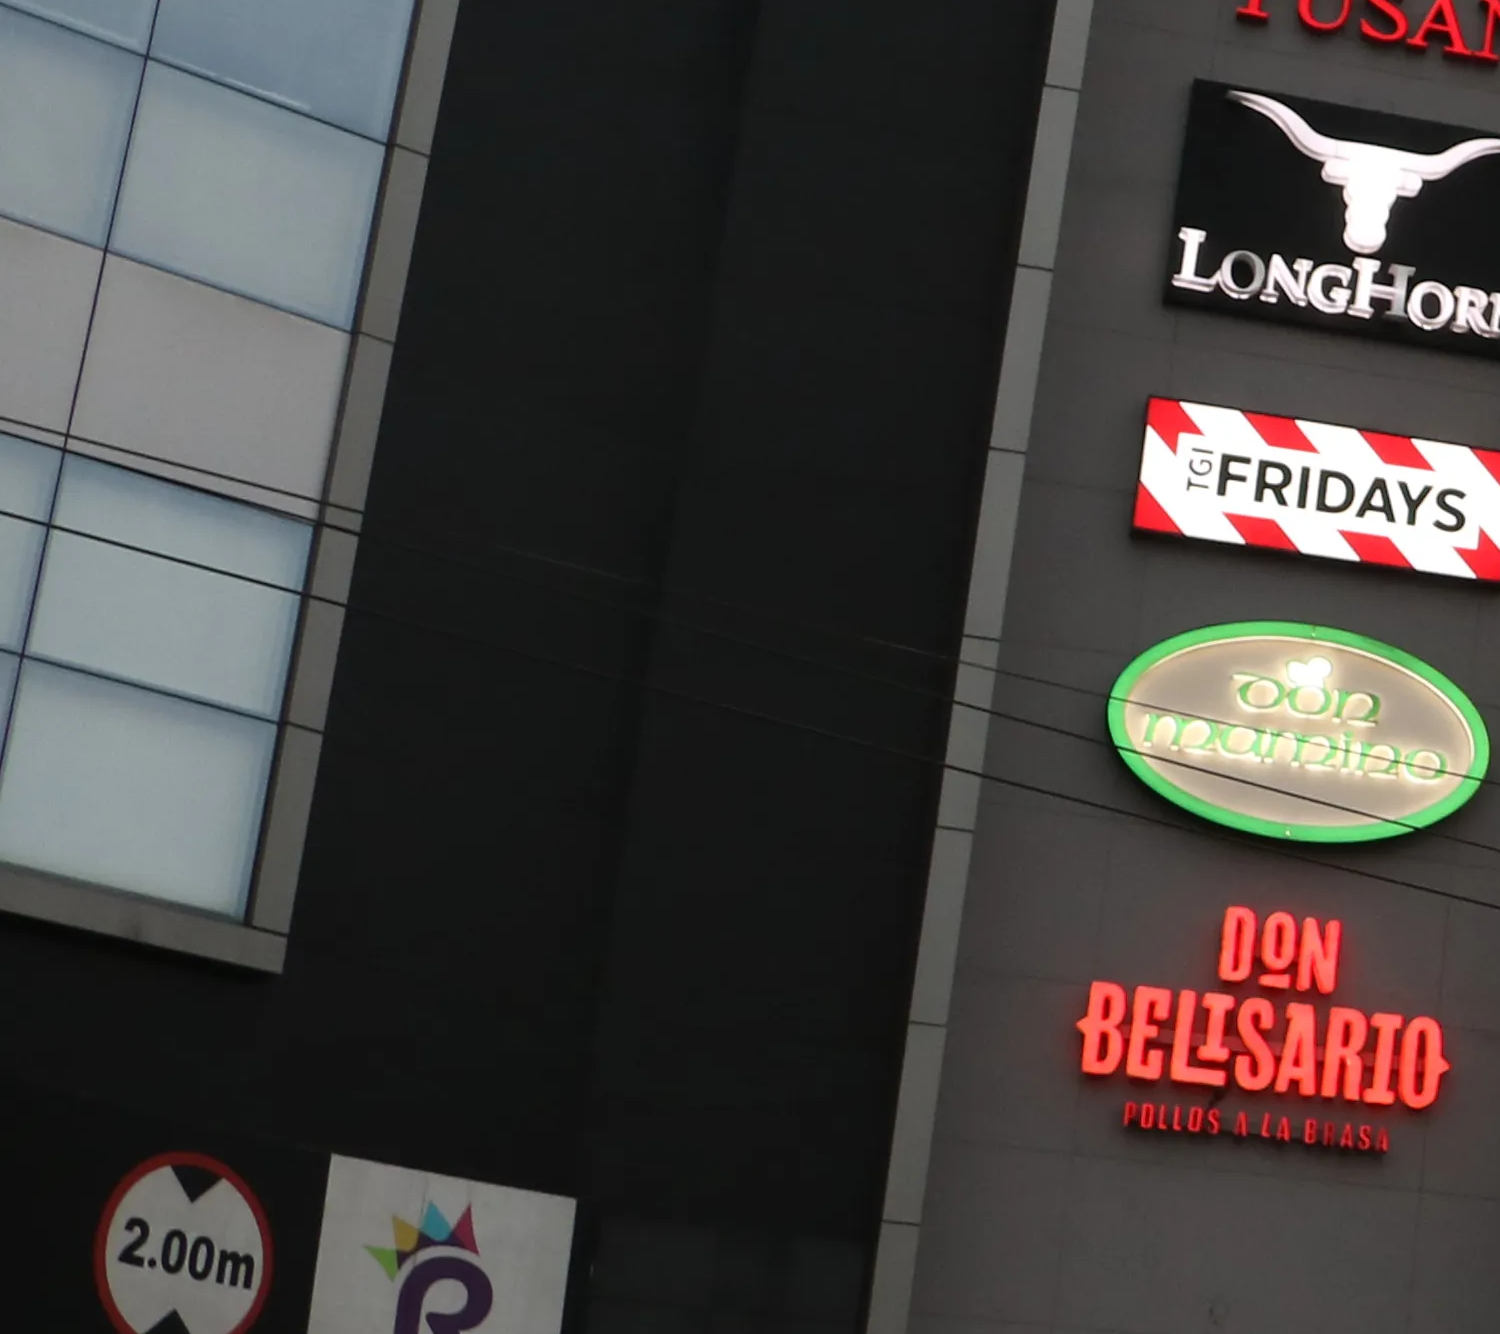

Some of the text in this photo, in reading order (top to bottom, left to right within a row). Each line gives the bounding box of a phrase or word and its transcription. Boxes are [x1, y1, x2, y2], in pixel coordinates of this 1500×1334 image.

[1186, 447, 1468, 533] TGI FRIDAYS
[1217, 905, 1342, 996] DON
[1075, 978, 1452, 1111] BELISARIO
[1122, 1100, 1390, 1153] POLLOS A LA BRASA
[116, 1217, 257, 1291] 2.00m
